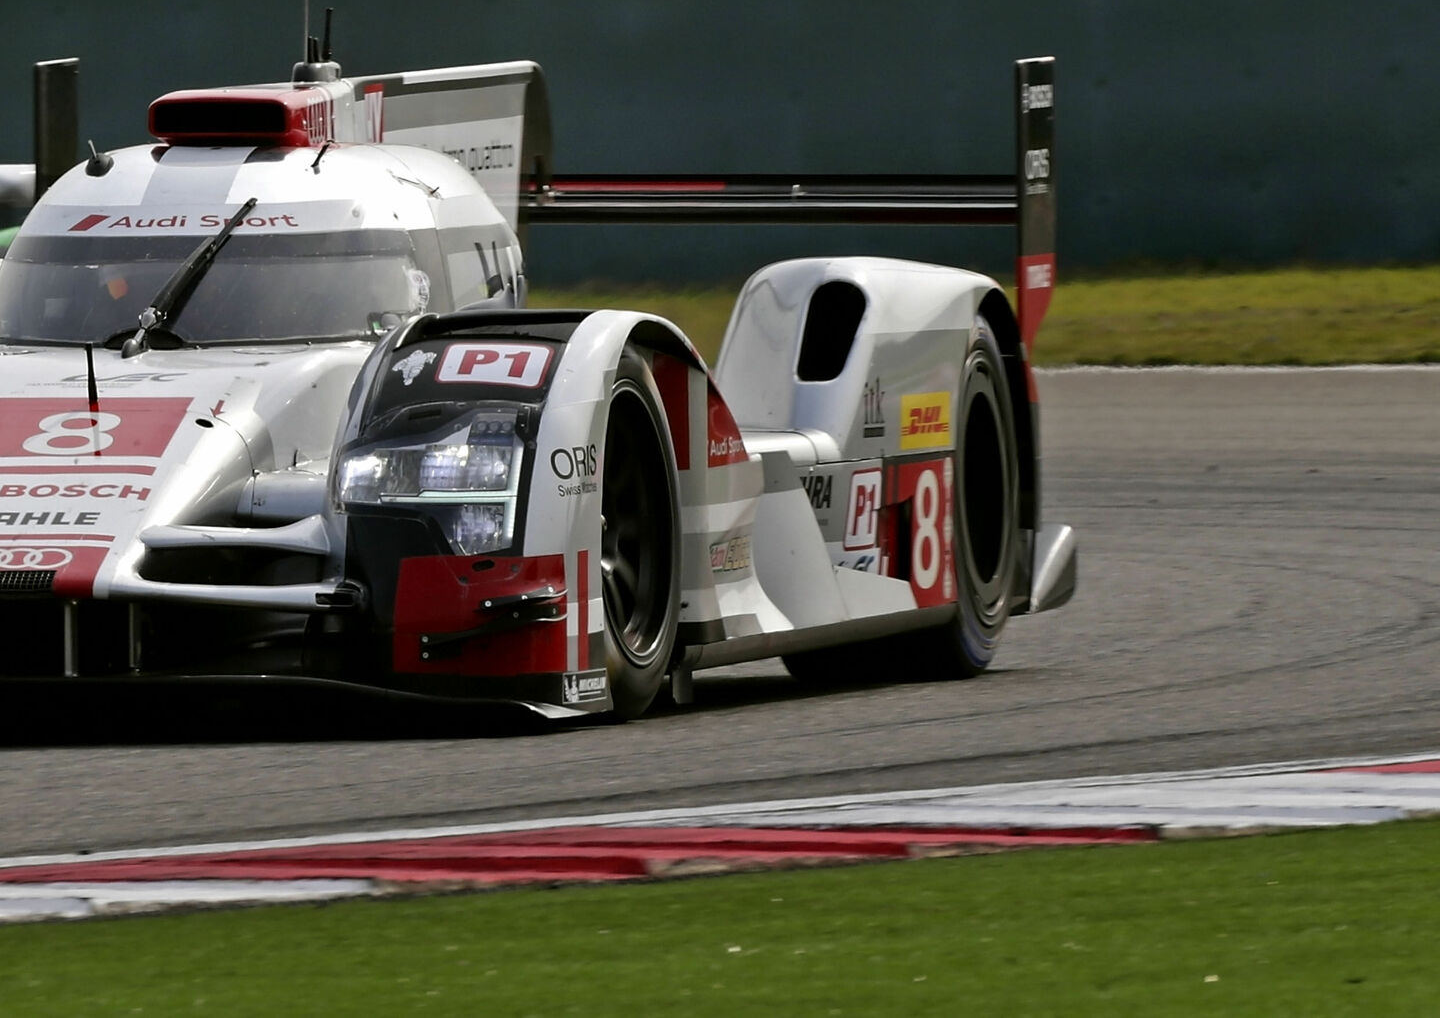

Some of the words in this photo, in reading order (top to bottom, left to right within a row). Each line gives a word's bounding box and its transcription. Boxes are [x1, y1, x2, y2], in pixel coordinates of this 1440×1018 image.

[107, 214, 187, 229] Audi
[199, 214, 299, 228] Sport
[457, 350, 531, 378] P1
[21, 411, 121, 456] 8
[710, 440, 728, 456] Audi
[550, 444, 597, 480] ORIS
[558, 484, 581, 497] Swiss
[852, 484, 876, 536] P1
[913, 470, 941, 589] 8
